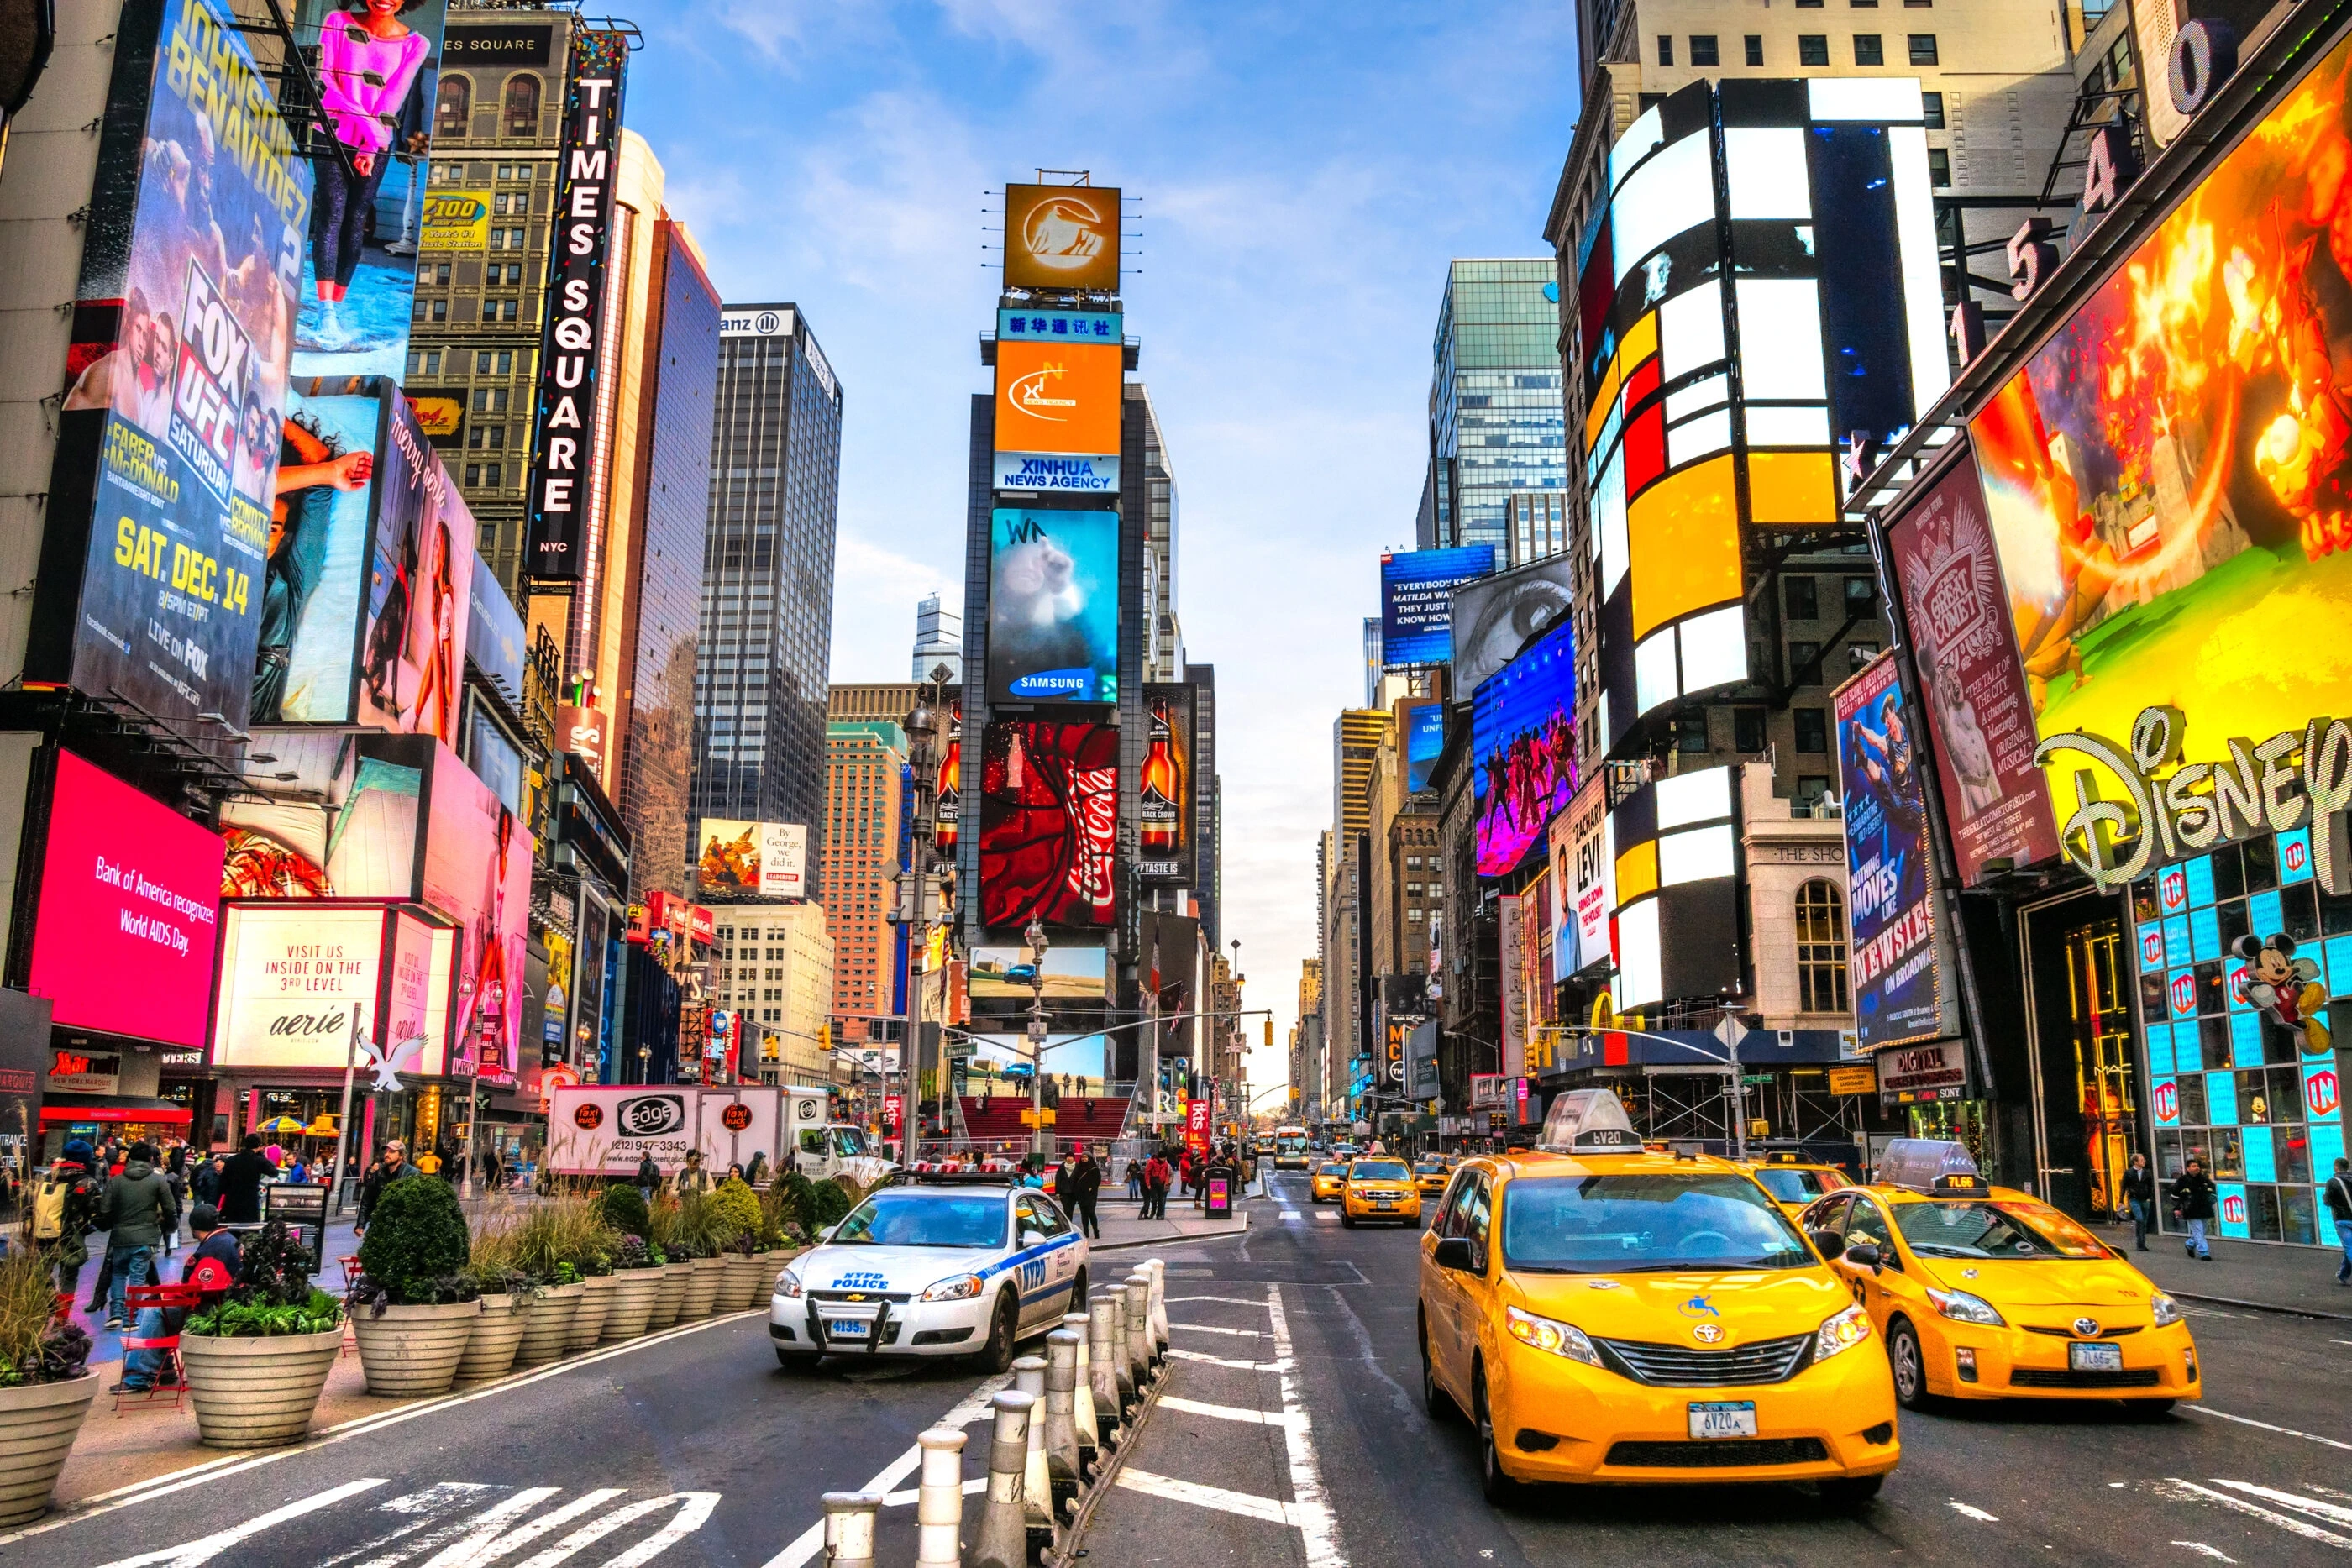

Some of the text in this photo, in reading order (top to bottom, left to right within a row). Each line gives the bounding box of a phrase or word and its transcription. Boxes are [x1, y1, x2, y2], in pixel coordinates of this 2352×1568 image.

[470, 40, 535, 50] SQUARE
[175, 0, 294, 173] JOHNSON
[167, 29, 307, 229] BENAVIDEZ
[278, 224, 302, 303] 2
[544, 79, 612, 511] TIMES SQUARE
[183, 265, 247, 409] FOX
[1010, 317, 1110, 336] 新华通讯社
[178, 355, 236, 461] UFC
[112, 422, 155, 463] FABER
[391, 411, 424, 490] merry
[171, 413, 231, 498] SATURDAY
[1021, 459, 1094, 476] XINHUA
[108, 445, 179, 504] McDONALD
[1005, 475, 1110, 489] NEWS AGENCY
[540, 543, 568, 552] NYC
[114, 516, 166, 582] SAT.
[171, 543, 219, 605] DEC.
[223, 567, 249, 615] 14
[158, 590, 186, 616] 8/5PM
[1392, 592, 1432, 603] MATILDA
[1931, 568, 1970, 621] GREAT
[470, 592, 500, 637] CHEVROLET
[1397, 615, 1426, 625] KNOW
[1398, 602, 1446, 614] THEY JUST
[1934, 593, 1977, 645] COMET
[148, 617, 171, 651] LIVE
[171, 638, 185, 662] ON
[184, 638, 209, 681] FOX
[1021, 676, 1084, 689] SAMSUNG
[1982, 663, 2003, 686] TALK
[2001, 655, 2011, 673] OF
[1848, 681, 1863, 702] SCORE
[1855, 691, 1867, 706] TONY
[1869, 677, 1887, 696] AWARD
[1976, 690, 1992, 711] THE
[1995, 725, 2030, 758] ORIGINAL
[766, 838, 801, 849] George,
[780, 828, 789, 838] By
[770, 857, 795, 868] did it.
[1576, 833, 1601, 894] LEVI
[1777, 847, 1807, 861] THE
[1170, 863, 1178, 873] IS
[1851, 852, 1881, 891] NOTHING
[96, 856, 214, 924] Bank of America recognizes
[1590, 884, 1604, 903] DOWN
[1852, 857, 1898, 926] MOVES
[1882, 894, 1898, 922] LIKE
[120, 908, 189, 957] World AIDS Day.
[287, 946, 344, 958] VISIT US
[265, 962, 362, 974] INSIDE ON THE
[1508, 907, 1525, 1037] PALACE
[281, 978, 344, 991] 3RD LEVEL
[1885, 974, 1896, 995] ON
[270, 1005, 344, 1036] aerie
[948, 1046, 972, 1056] Broadway
[1897, 1048, 1943, 1072] DIGITAL
[86, 1078, 112, 1087] MARQUIS
[1917, 1088, 1960, 1100] Canon SONY
[631, 1105, 672, 1125] edge
[1193, 1103, 1206, 1130] tkts
[612, 1141, 687, 1151] (212) 947-3343
[1948, 1176, 1974, 1188] 7L66
[831, 1280, 889, 1290] POLICE
[1022, 1259, 1047, 1291] NYPD
[832, 1319, 860, 1333] 4135
